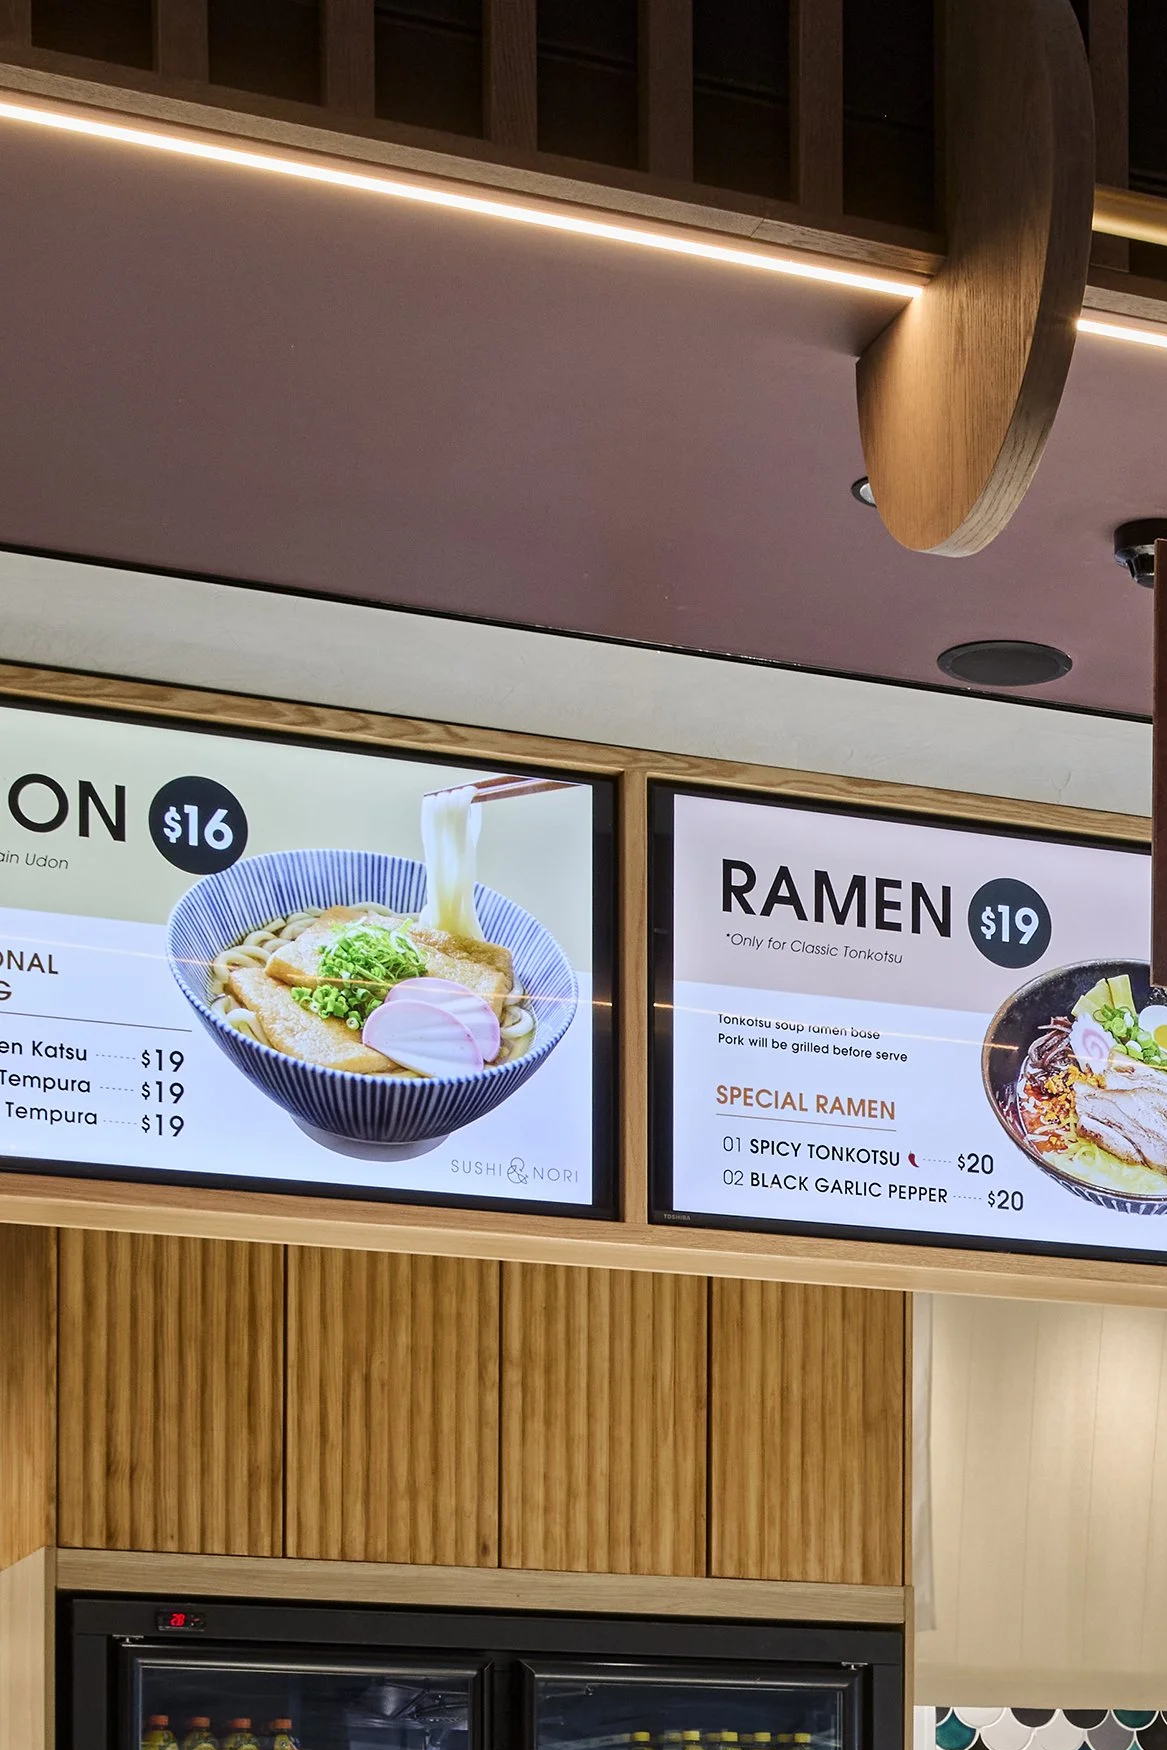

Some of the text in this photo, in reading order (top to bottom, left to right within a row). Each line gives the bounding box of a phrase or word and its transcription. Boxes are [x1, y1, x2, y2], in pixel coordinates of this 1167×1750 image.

[8, 773, 233, 850] ON $16
[25, 852, 69, 869] Udon
[722, 858, 1039, 945] RAMEN $19
[0, 950, 59, 975] NAL
[767, 937, 787, 950] for
[790, 940, 838, 957] Classic
[843, 945, 903, 964] Tonkotsu
[718, 1013, 880, 1040] Tonkotsu soup ramen base
[32, 1041, 87, 1061] Katsu
[141, 1049, 185, 1072] $19
[718, 1033, 908, 1062] Pork will be grilled before serve
[0, 1069, 185, 1104] Tempura $19
[716, 1084, 896, 1120] SPECIAL RAMEN
[5, 1102, 185, 1137] Tempura $19
[451, 1157, 578, 1184] SUSHI & NORI
[723, 1136, 994, 1175] 01 SPICY TONKOTSU $20
[723, 1169, 1024, 1211] 02 BLACK GARLIC PEPPER $20
[663, 1213, 690, 1221] TOSHIBA
